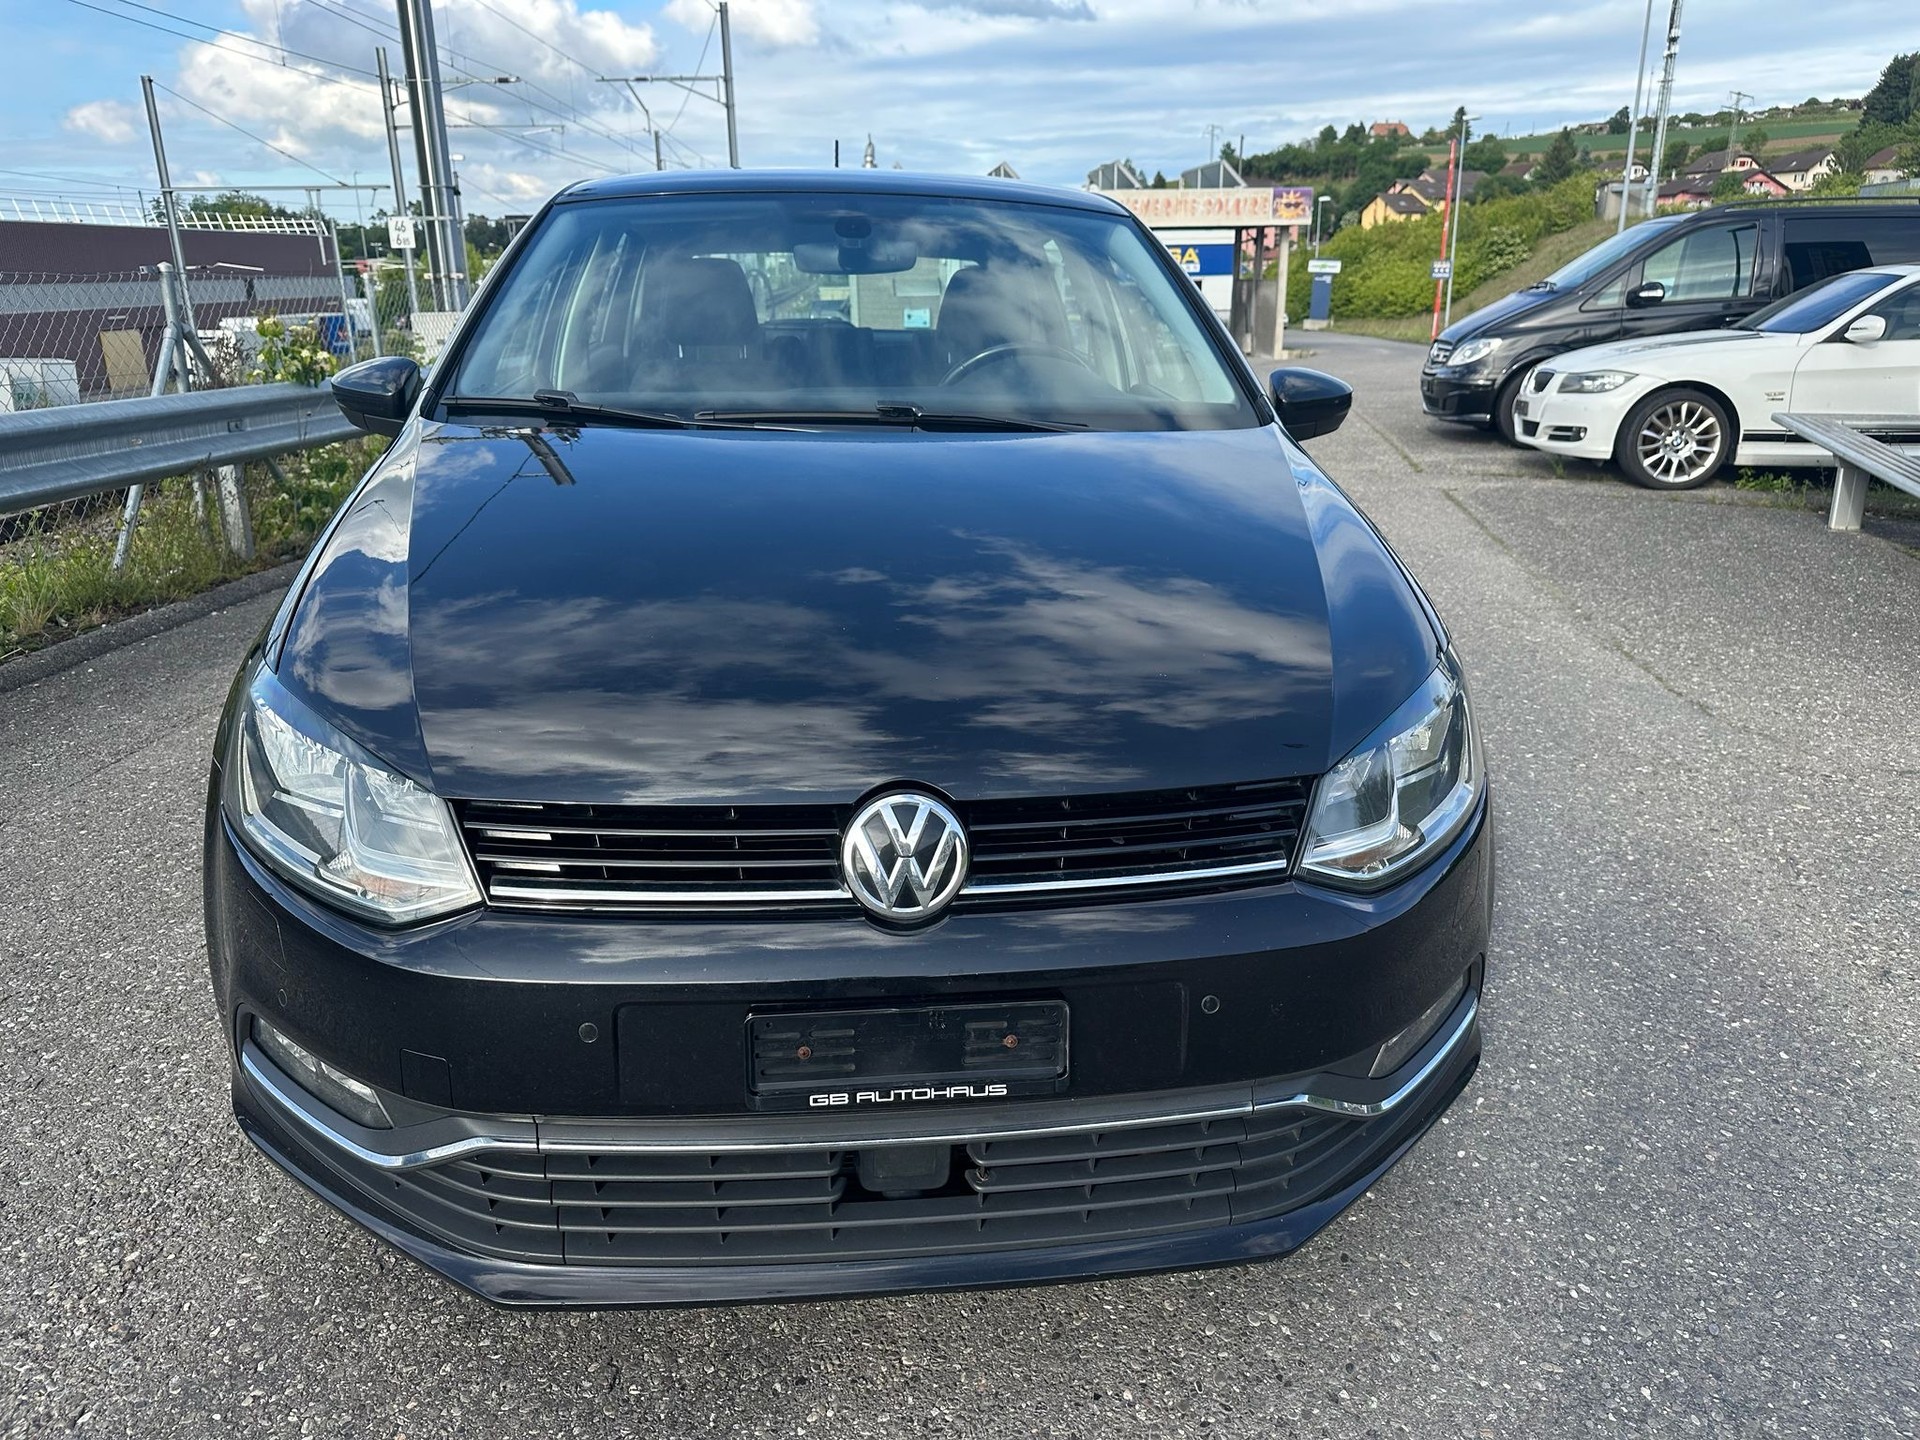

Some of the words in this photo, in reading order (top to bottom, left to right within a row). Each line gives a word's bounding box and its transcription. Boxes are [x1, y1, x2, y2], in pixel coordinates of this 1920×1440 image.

[395, 220, 407, 233] 46
[809, 1093, 849, 1107] GB
[856, 1084, 1008, 1104] AUTOHAUS
